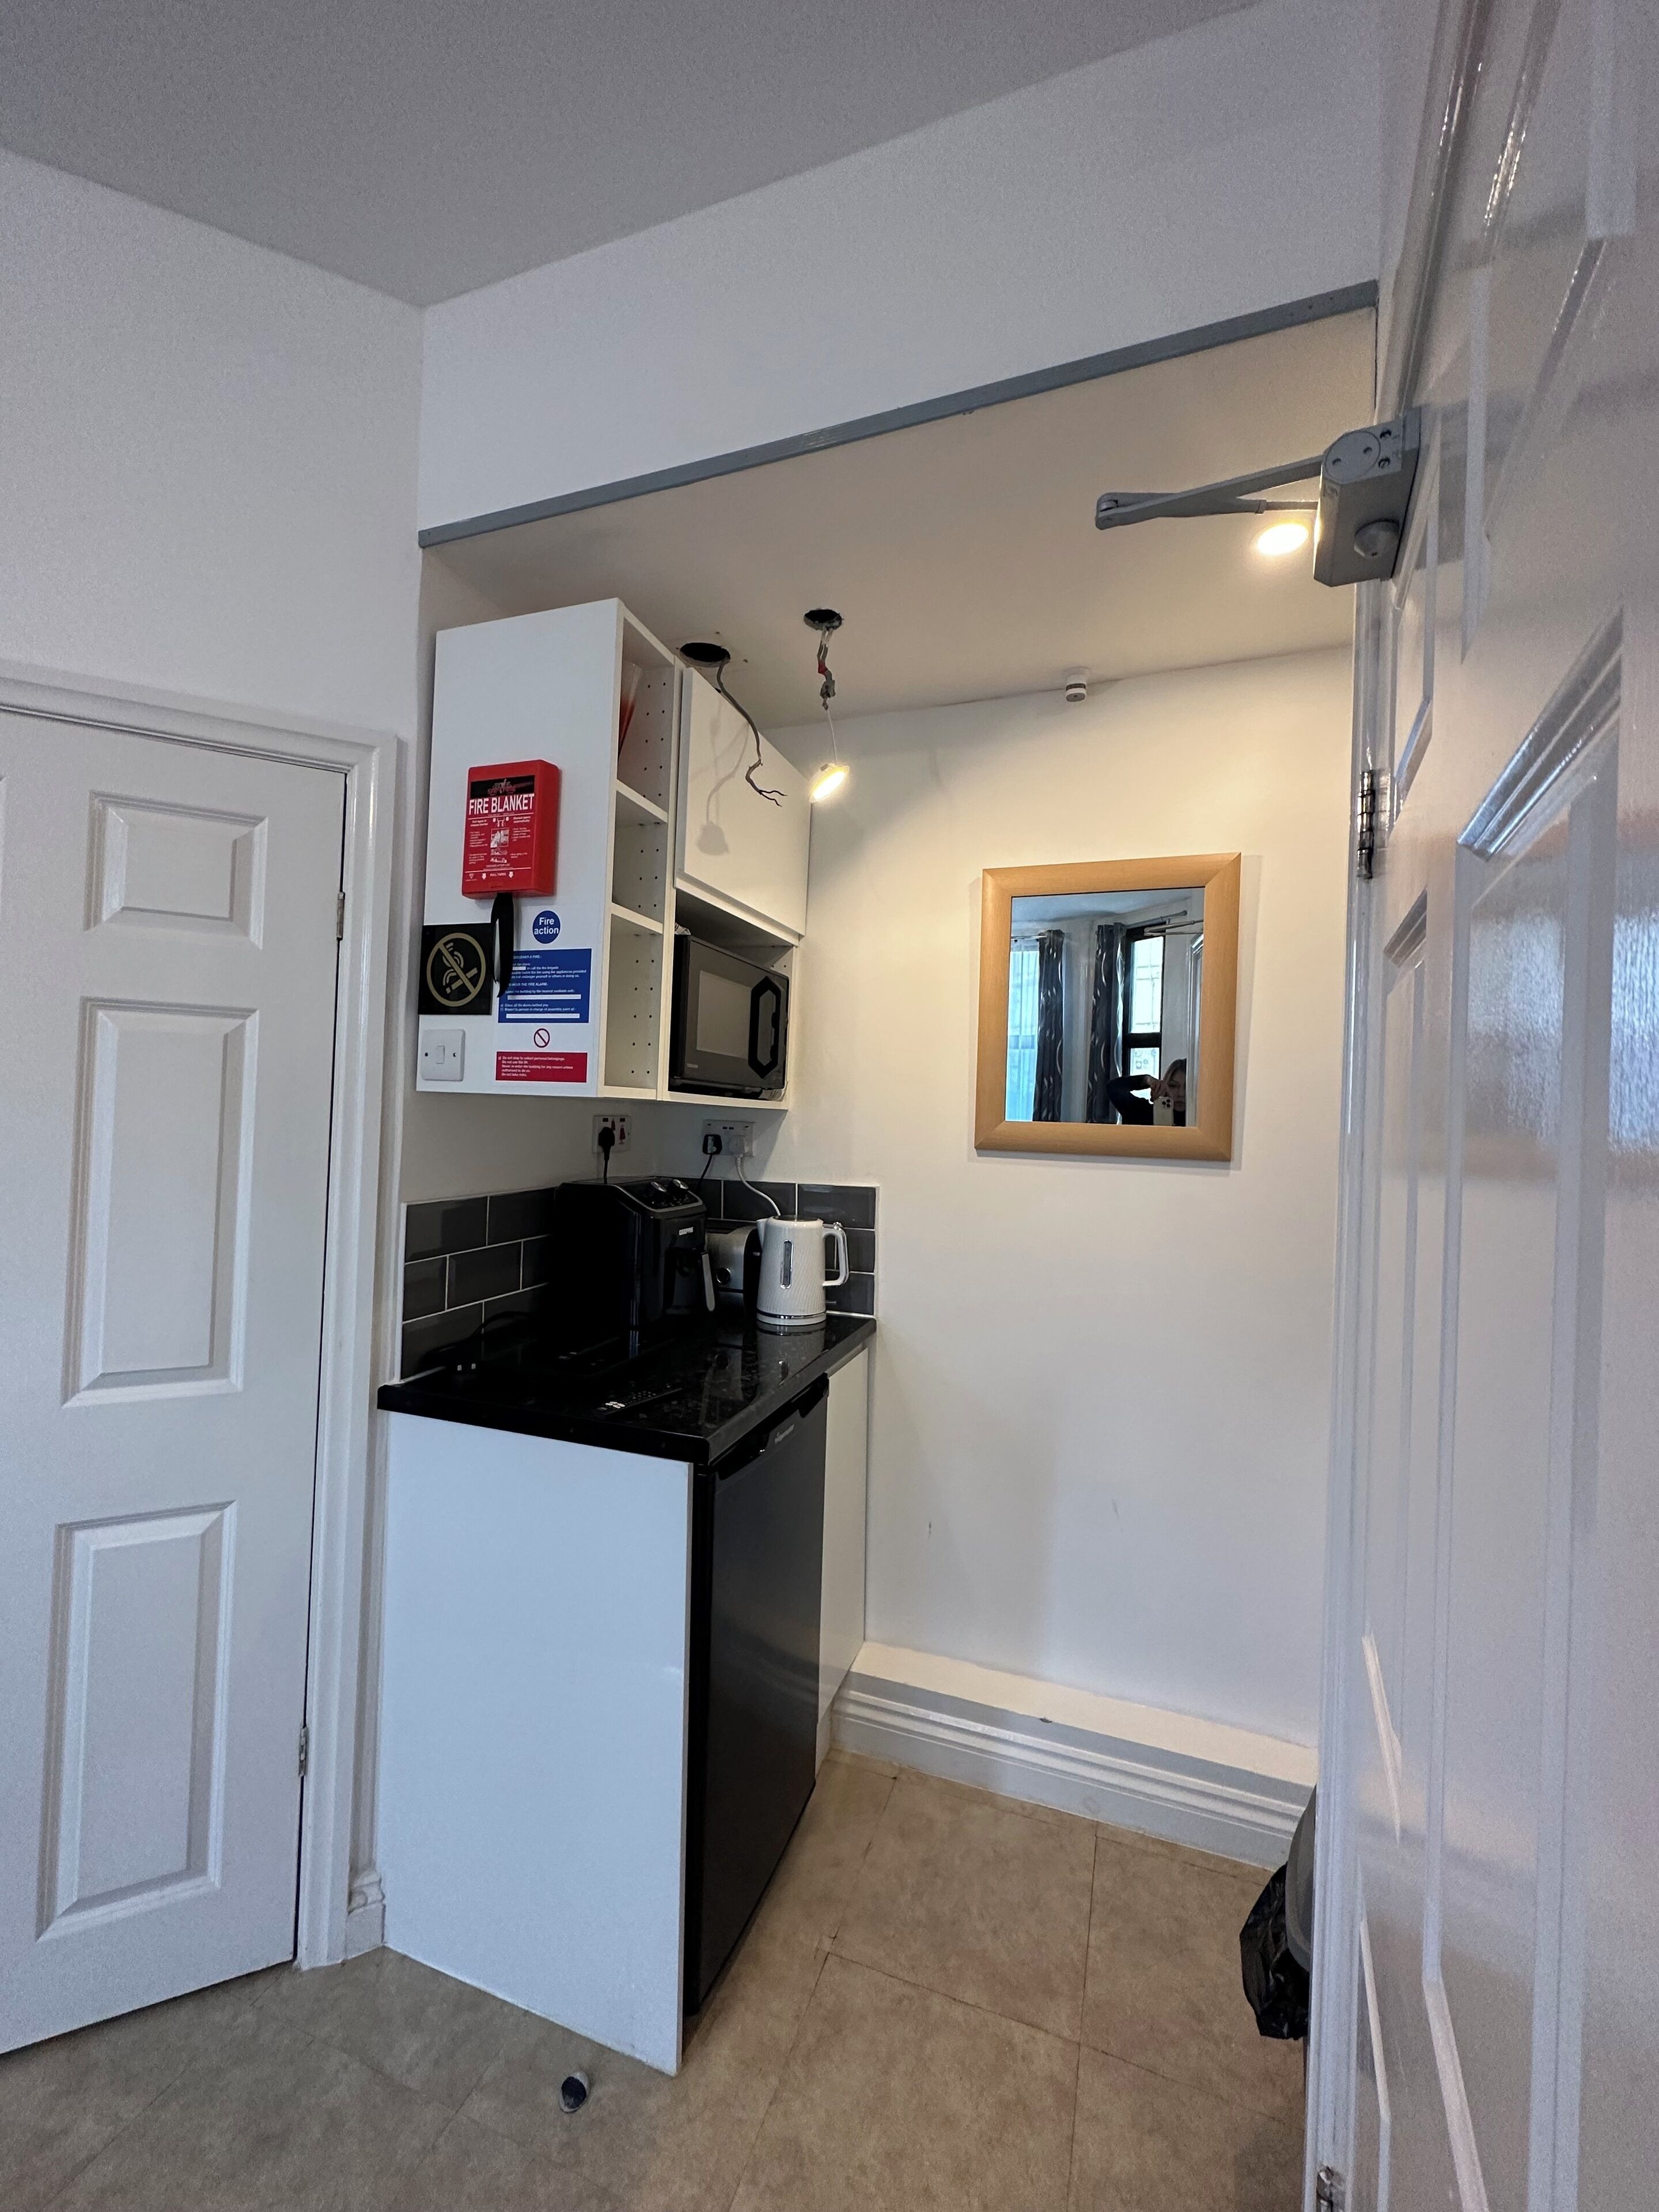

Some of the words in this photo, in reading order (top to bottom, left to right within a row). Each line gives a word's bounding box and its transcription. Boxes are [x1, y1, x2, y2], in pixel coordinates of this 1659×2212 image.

[469, 798, 489, 815] FIRE
[491, 793, 535, 813] BLANKET
[539, 917, 554, 925] Fire
[534, 926, 559, 934] action
